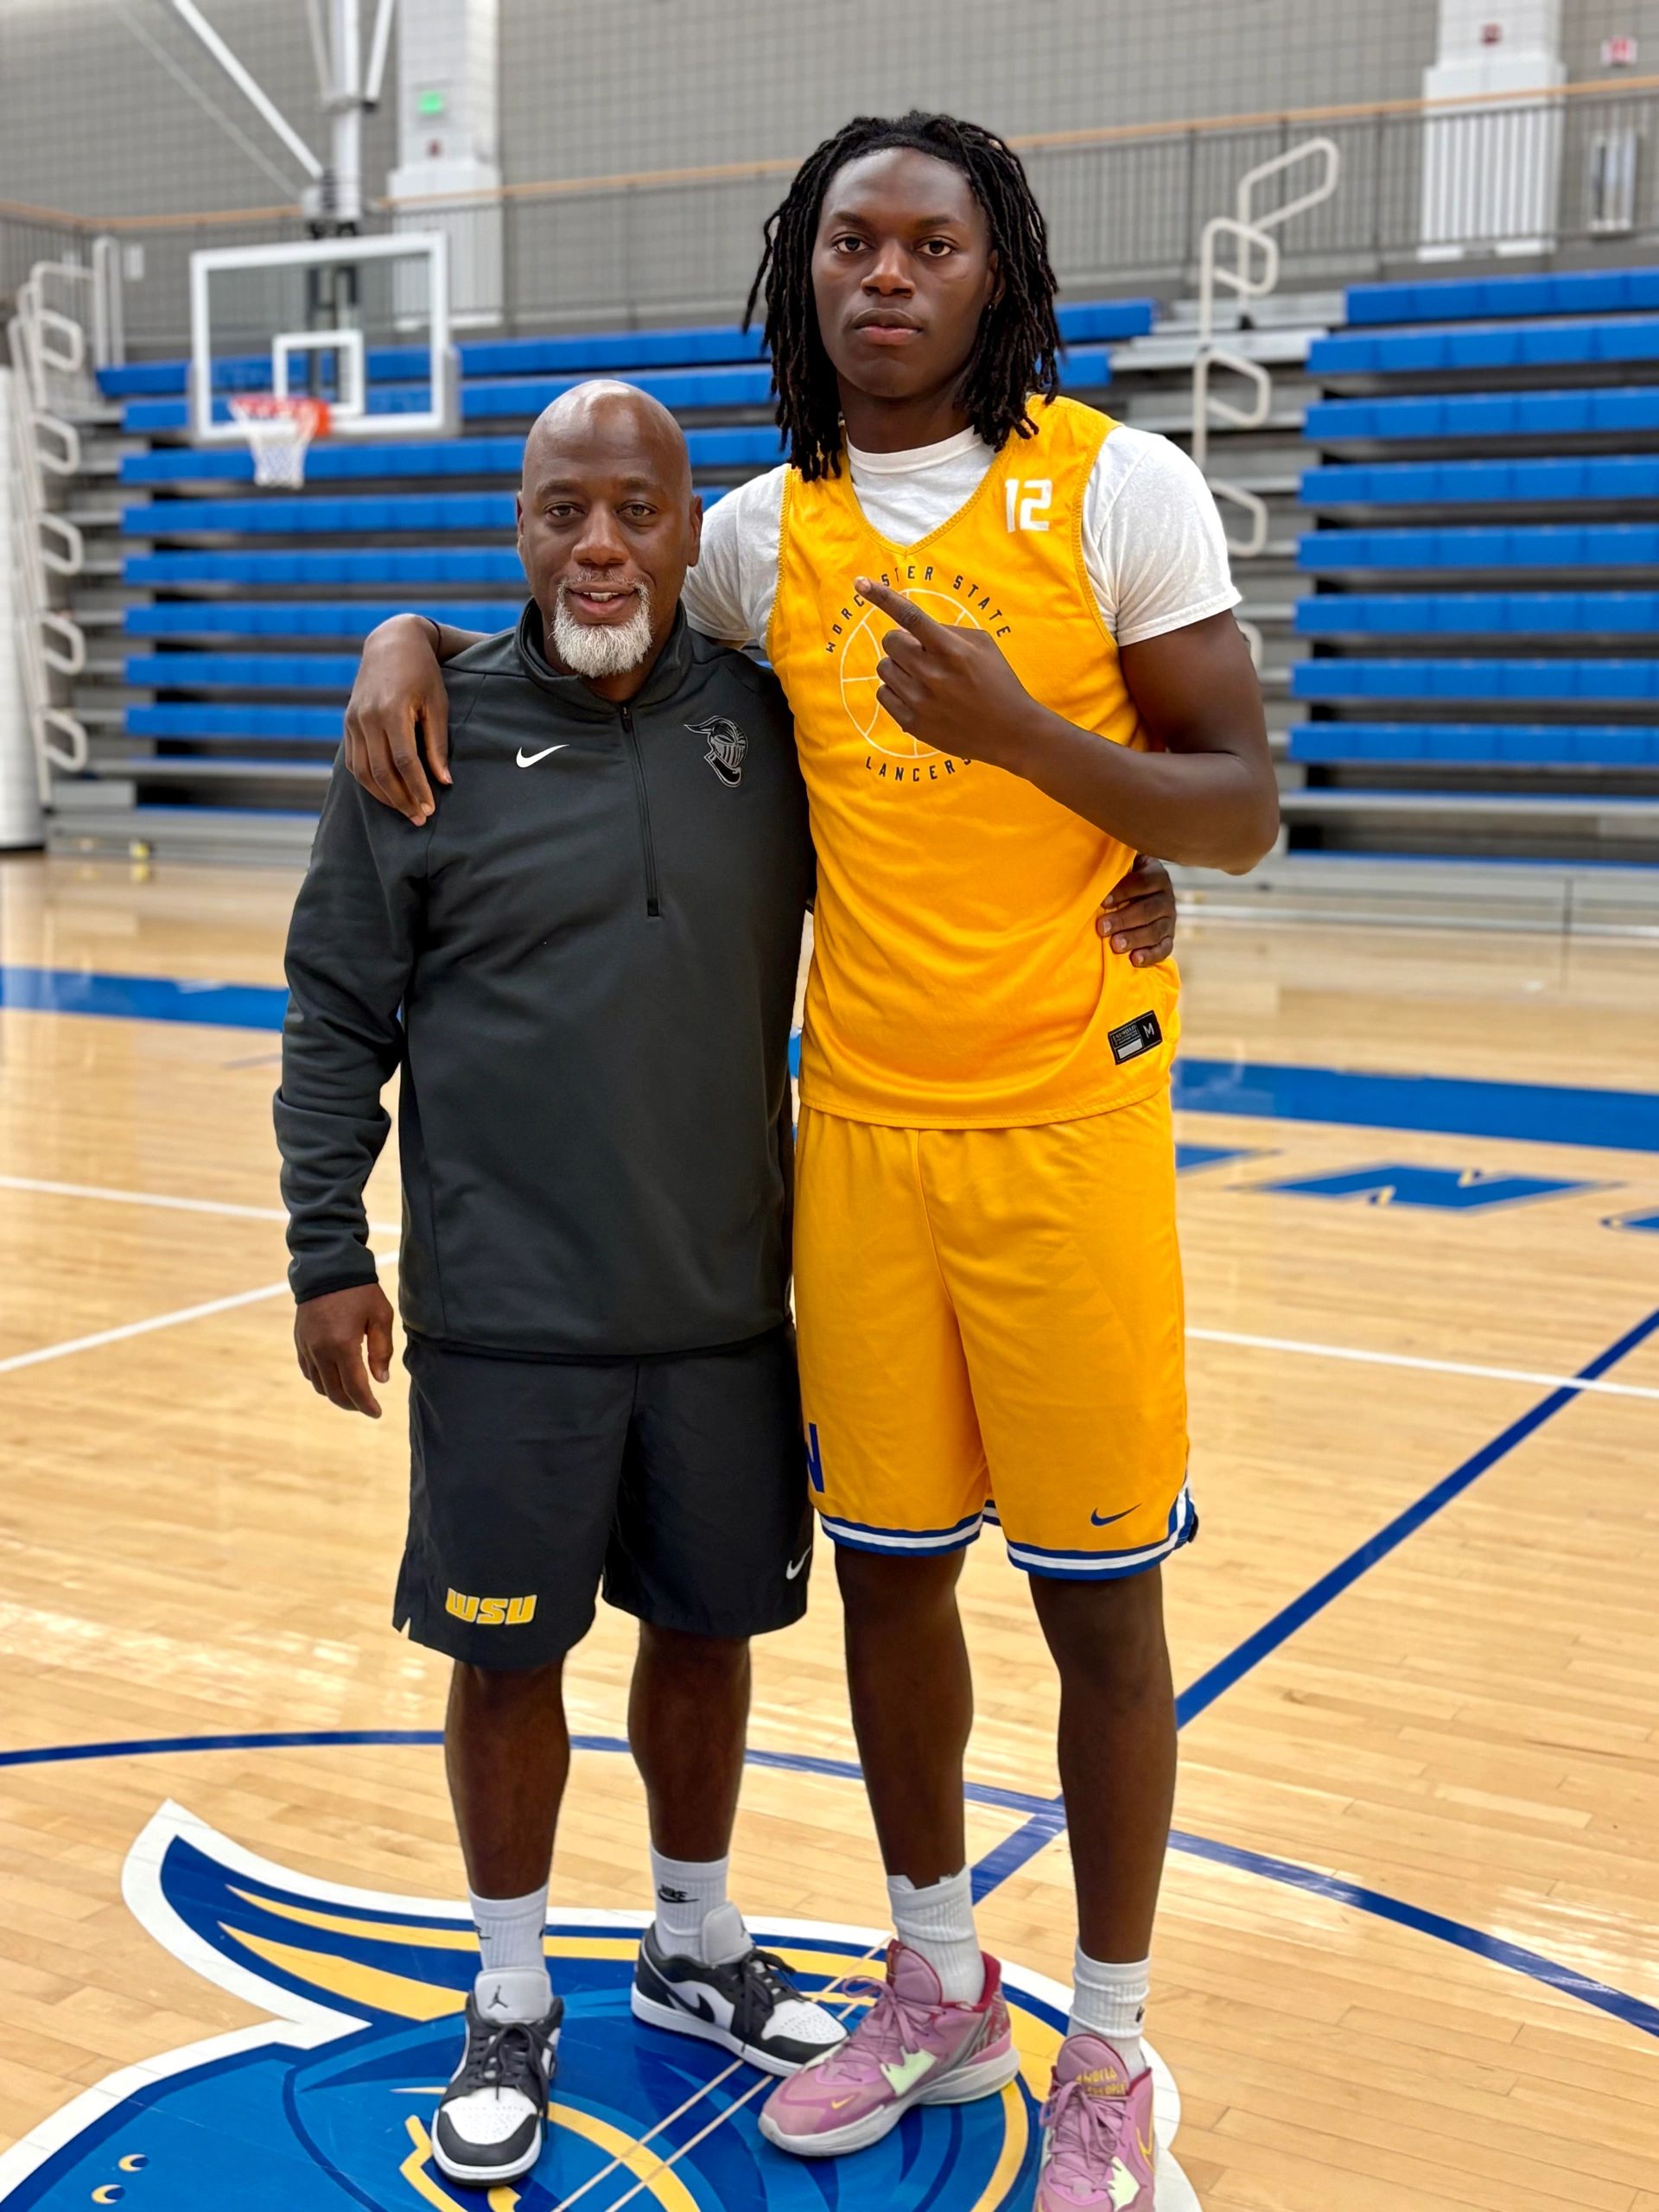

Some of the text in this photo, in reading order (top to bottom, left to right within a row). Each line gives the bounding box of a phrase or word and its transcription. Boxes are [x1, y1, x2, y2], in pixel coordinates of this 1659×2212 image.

[1005, 479, 1052, 533] 12
[826, 566, 1011, 653] WORCSTER STATE
[1142, 1022, 1155, 1039] M
[445, 1587, 537, 1625] WSU
